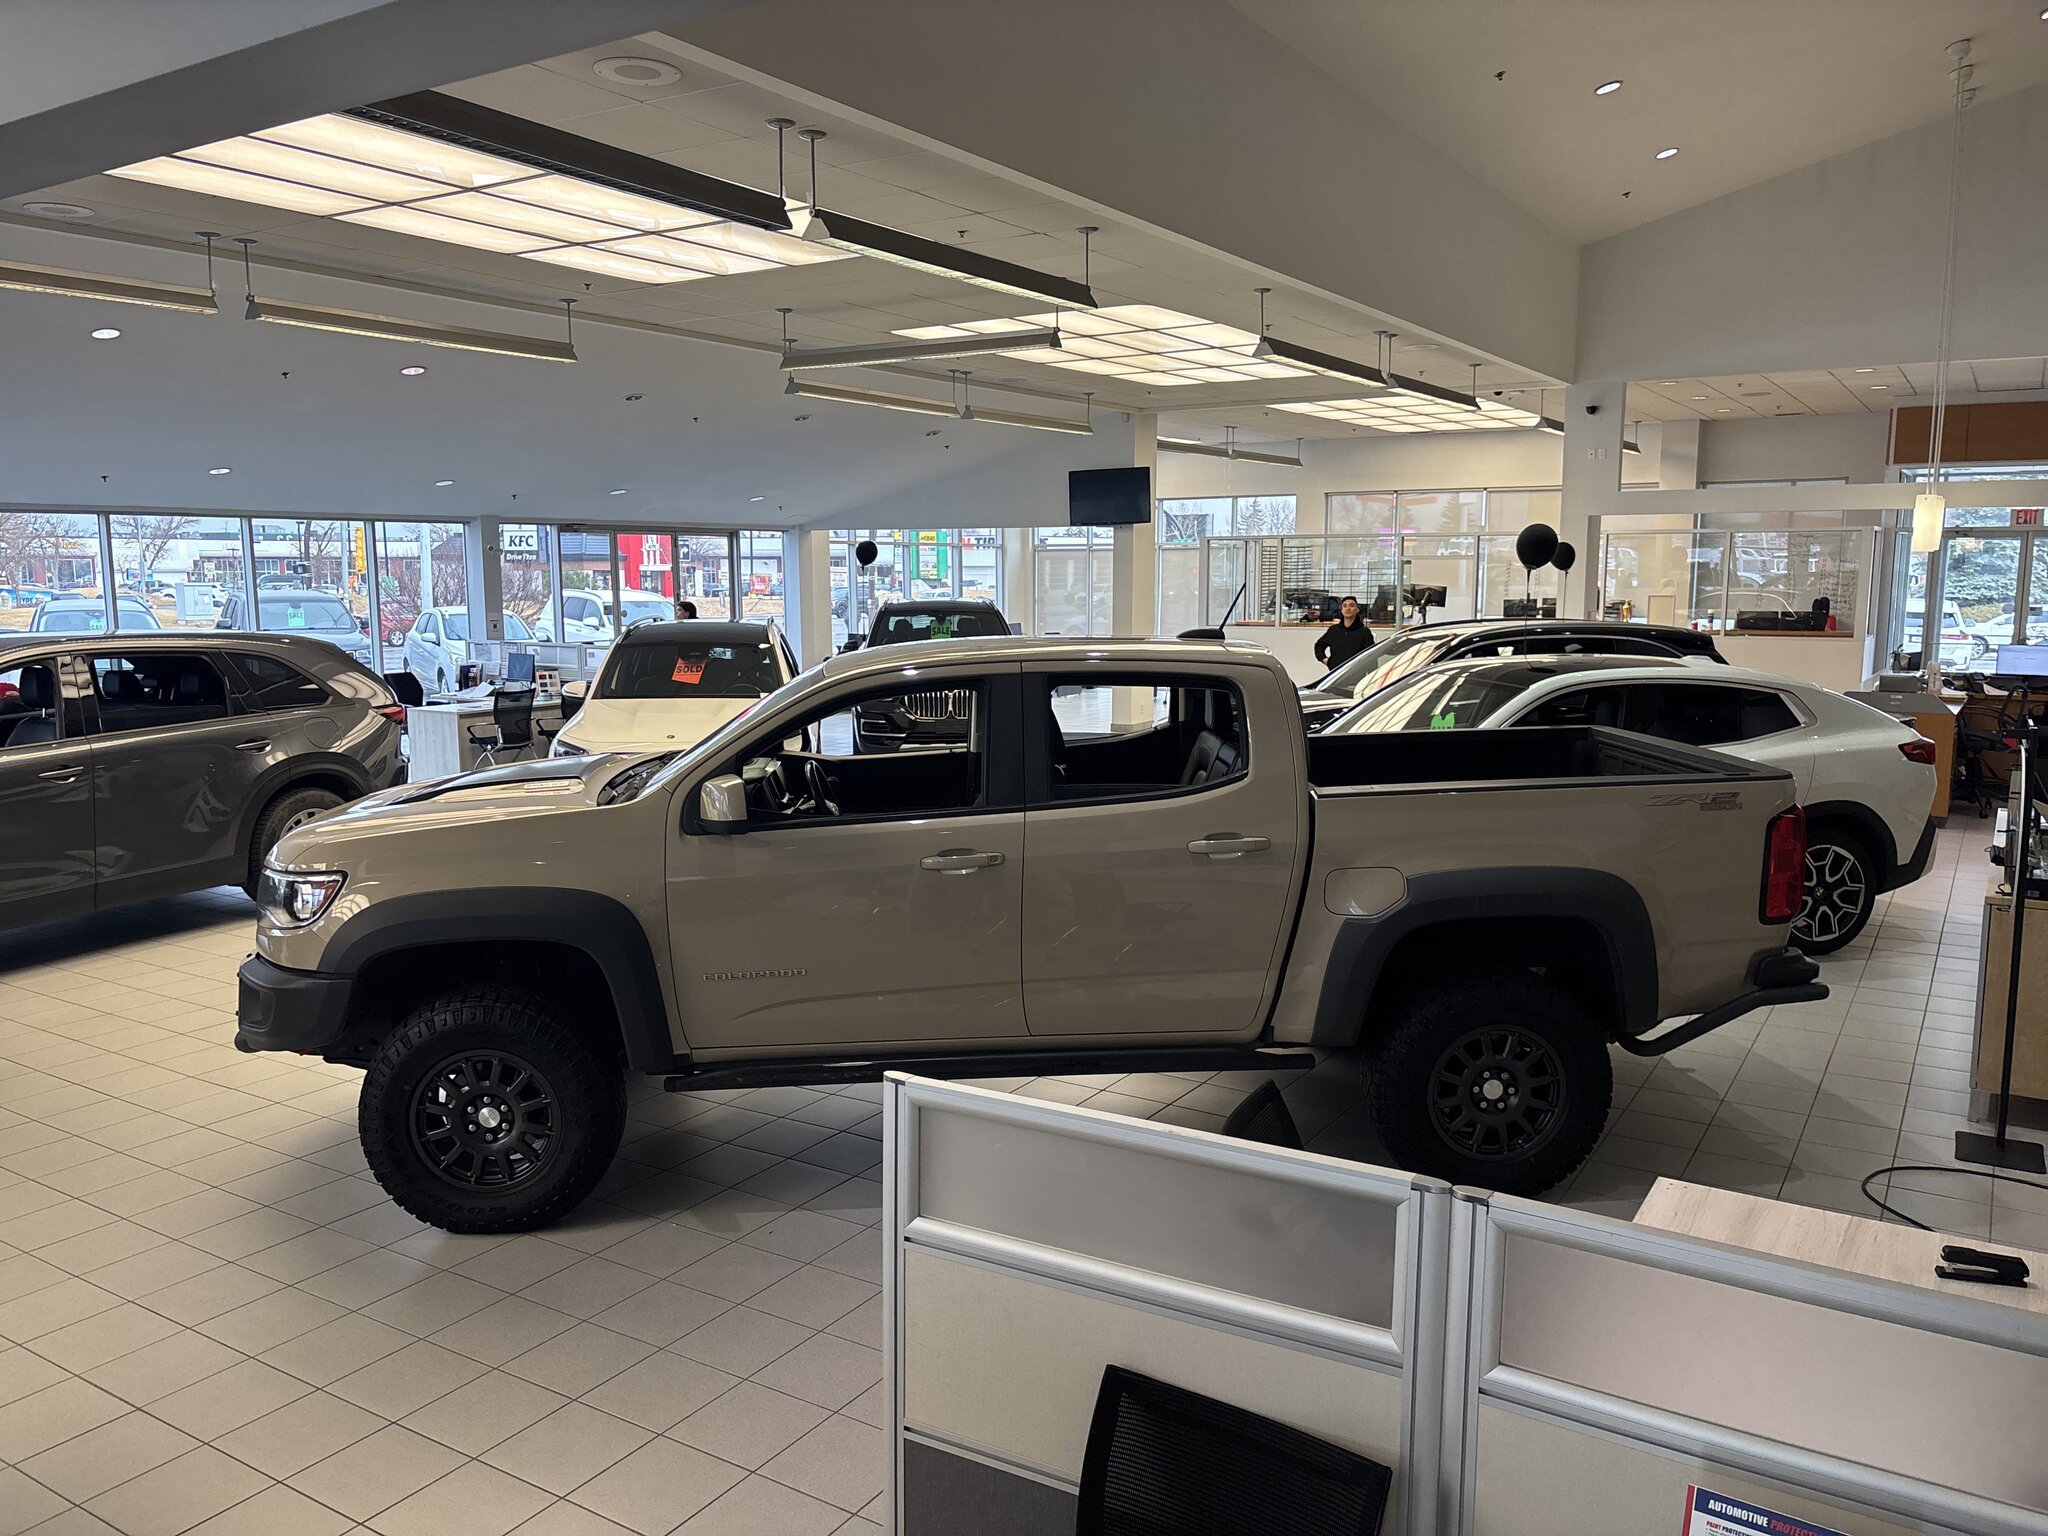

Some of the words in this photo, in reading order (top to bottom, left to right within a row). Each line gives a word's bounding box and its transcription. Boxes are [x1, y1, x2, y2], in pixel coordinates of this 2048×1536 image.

[2015, 509, 2039, 525] EXIT
[508, 535, 534, 547] KFC
[506, 553, 522, 561] Drive
[931, 626, 950, 636] SALE
[676, 664, 703, 674] SOLD
[702, 968, 806, 981] COLORADO
[1708, 1499, 1768, 1527] AUTOMOTIVE
[1706, 1521, 1722, 1531] PAINT
